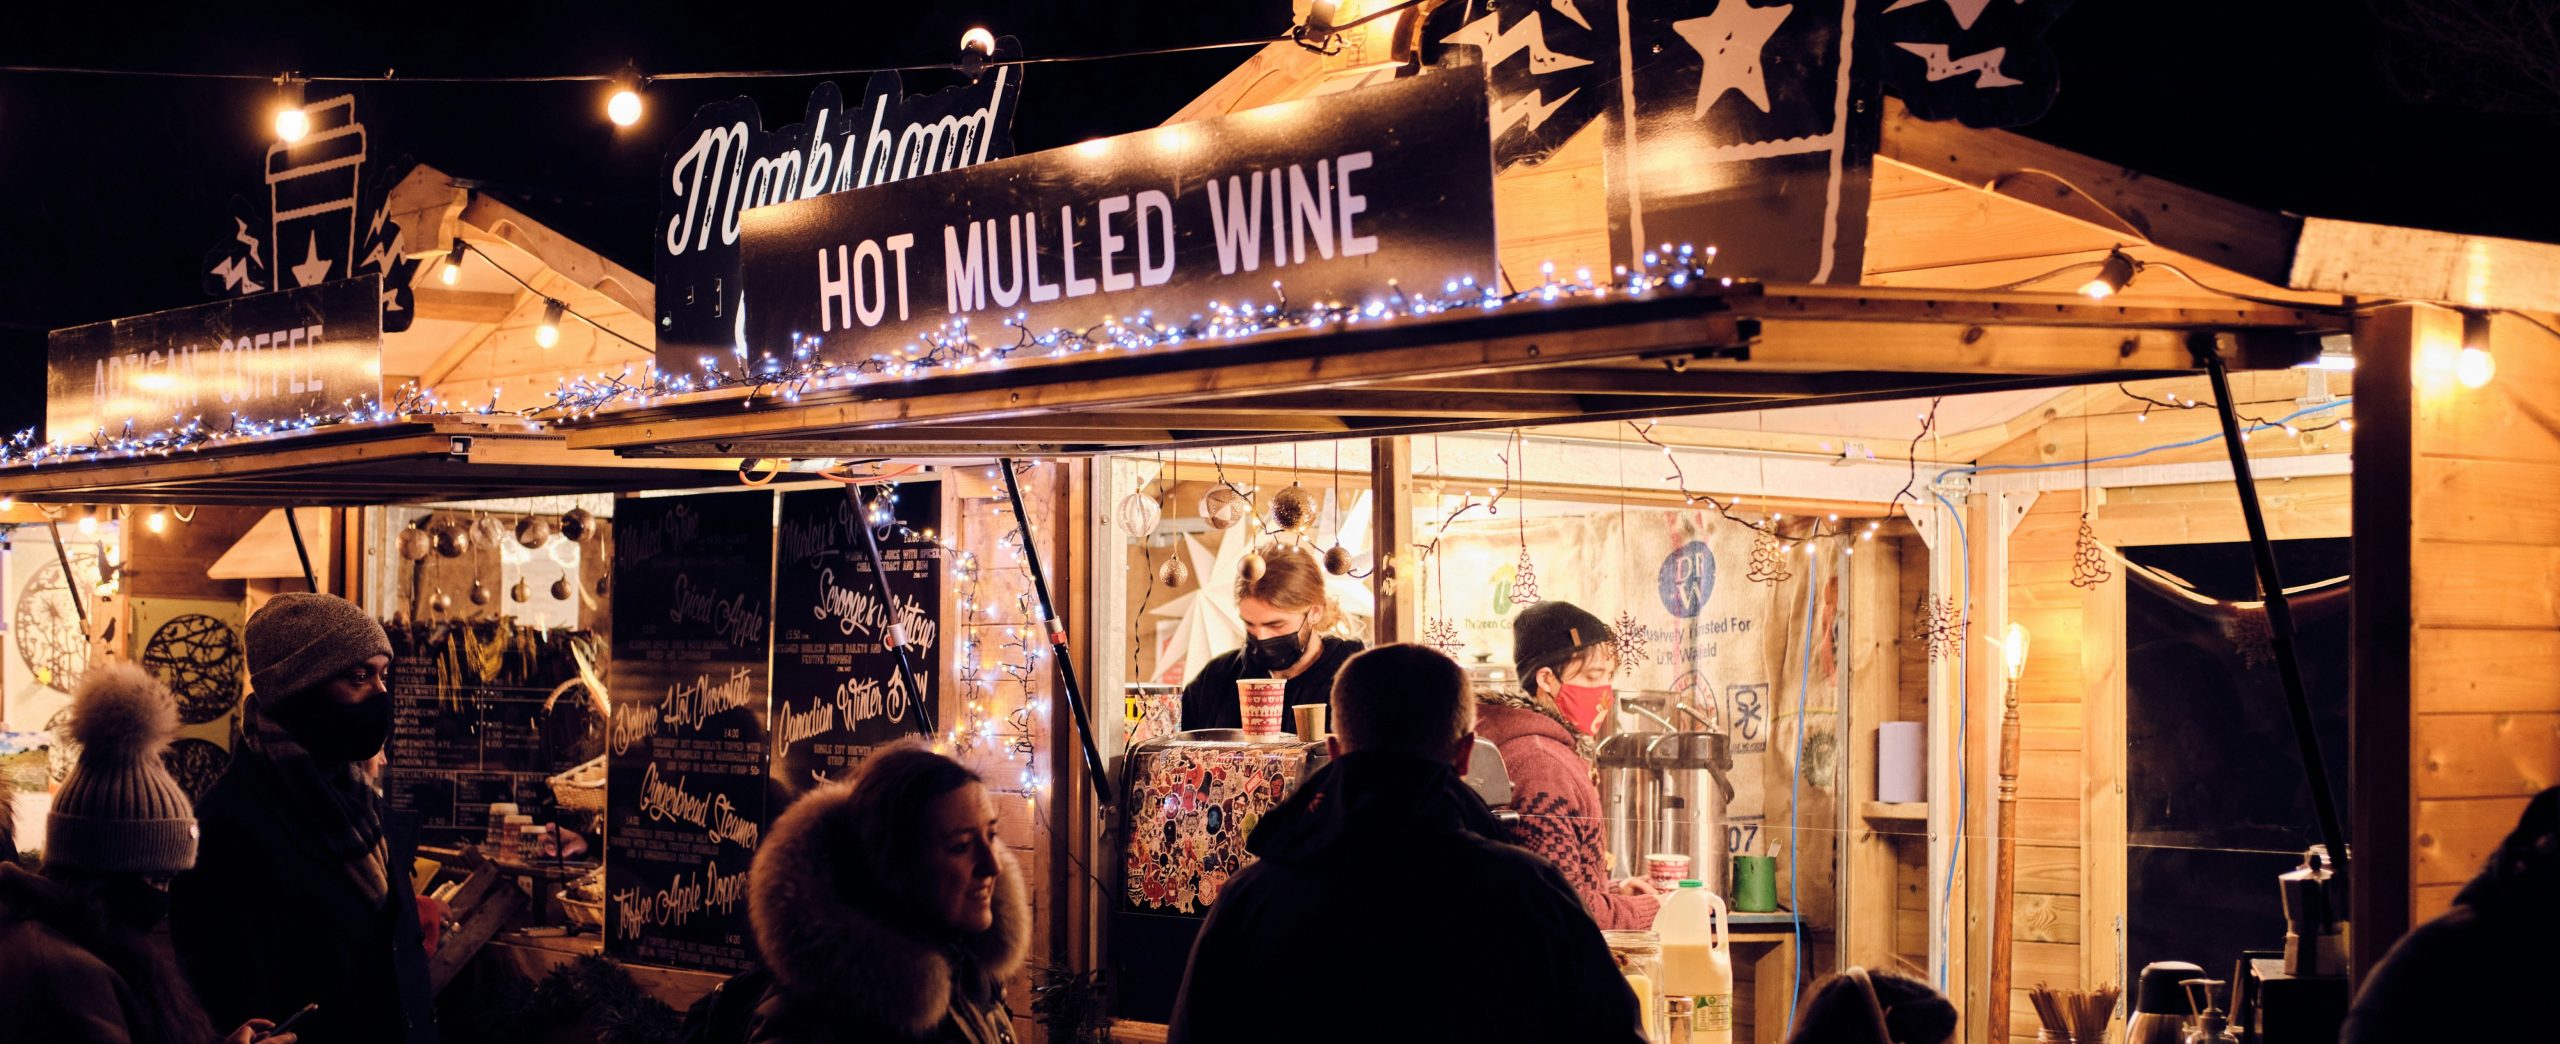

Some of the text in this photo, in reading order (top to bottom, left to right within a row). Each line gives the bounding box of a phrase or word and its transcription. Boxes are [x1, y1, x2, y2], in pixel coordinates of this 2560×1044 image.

[667, 64, 1008, 257] Monkshood
[818, 232, 914, 332] HOT
[944, 190, 1175, 314] MULLED
[1207, 150, 1379, 276] WINE
[219, 333, 324, 405] COFFEE
[715, 593, 763, 648] Apple
[813, 567, 937, 660] Scrooge's ghtcap
[1731, 616, 1752, 632] For
[660, 682, 697, 736] Hot
[693, 666, 751, 731] Chocolate
[779, 663, 929, 758] Canadian Winter Bw
[640, 761, 758, 850] Gingerbread Steamer
[612, 886, 652, 940] Toffee
[656, 871, 702, 927] Apple
